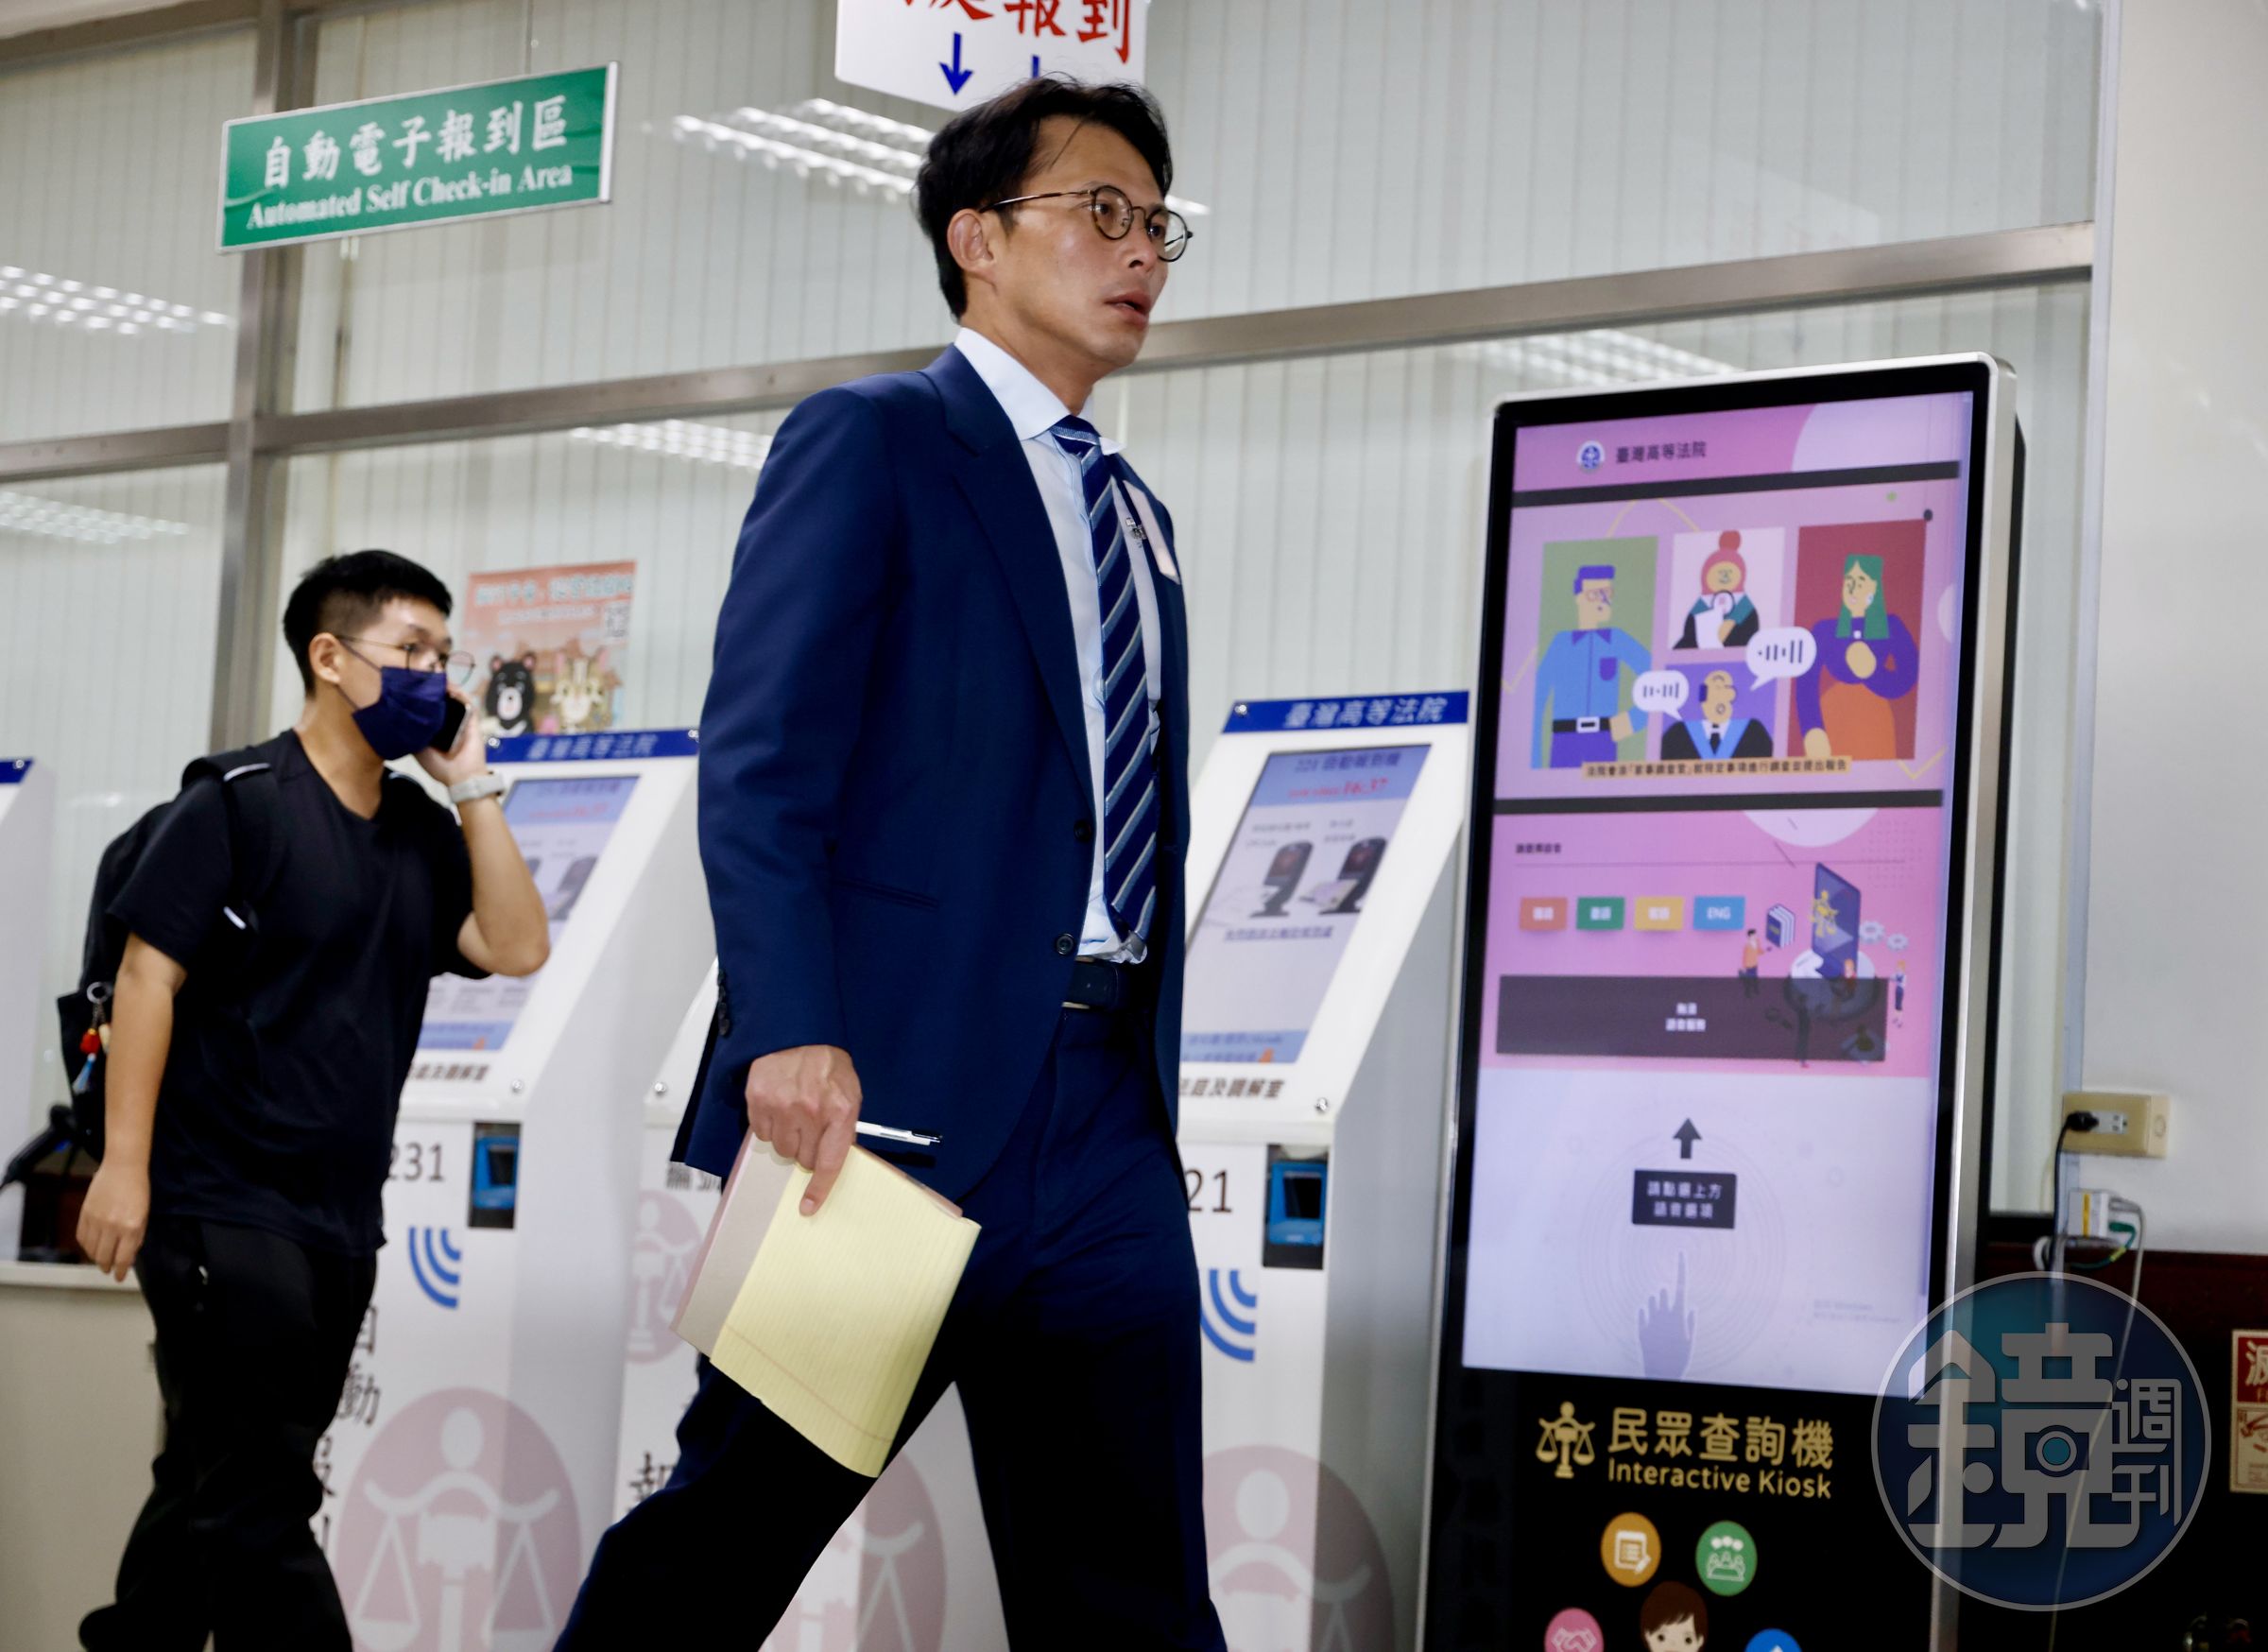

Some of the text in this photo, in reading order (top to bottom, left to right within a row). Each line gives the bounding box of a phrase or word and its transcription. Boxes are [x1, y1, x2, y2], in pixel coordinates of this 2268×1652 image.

[264, 95, 567, 189] 自動電子報到區
[246, 163, 574, 230] Automated Self Check-in Area
[1706, 906, 1731, 921] ENG
[1607, 1406, 1834, 1471] 民眾查詢機
[1608, 1457, 1832, 1500] Interactive Kiosk
